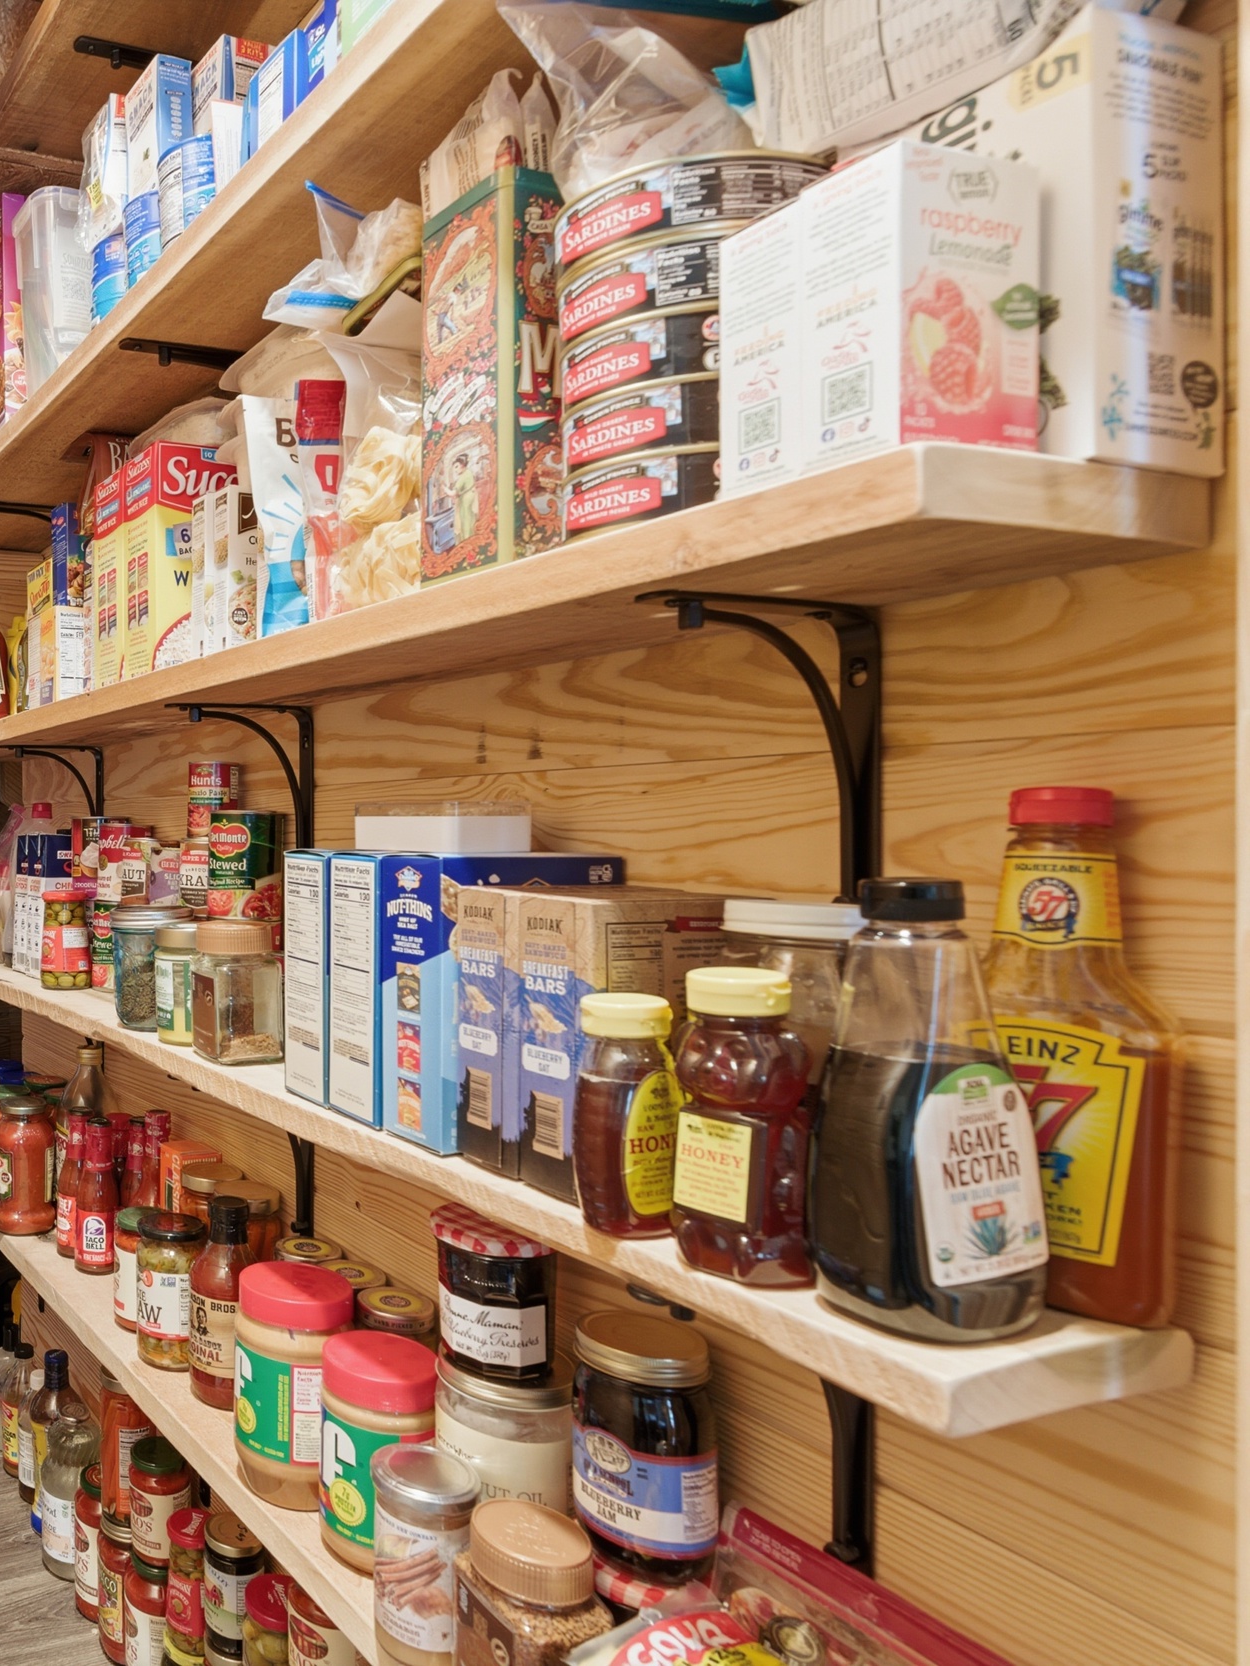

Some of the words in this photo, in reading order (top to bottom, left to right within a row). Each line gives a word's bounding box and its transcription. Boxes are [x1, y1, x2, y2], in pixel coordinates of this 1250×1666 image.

[1035, 53, 1079, 90] 5
[954, 170, 990, 190] TRUE
[531, 222, 550, 231] CASA
[565, 201, 652, 252] SARDINES
[919, 206, 1023, 247] raspberry
[928, 233, 1014, 267] Lemonade
[562, 283, 636, 331] SARDINES
[815, 299, 878, 330] AMERICA
[733, 341, 786, 367] AMERICA
[566, 353, 640, 394] SARDINES
[571, 417, 656, 455] SARDINES
[570, 487, 651, 521] SARDINES
[180, 528, 191, 544] 6
[174, 570, 191, 587] W
[219, 832, 248, 844] Monte
[209, 858, 247, 871] Stewed
[356, 868, 371, 876] Facts
[1013, 862, 1093, 875] SQUEEZABLE
[386, 899, 433, 922] NUT-THINS
[463, 905, 494, 921] KODIAK
[1027, 890, 1065, 921] 57
[526, 916, 564, 933] KODIAK
[459, 945, 499, 964] BREAKFAST
[460, 961, 496, 978] BARS
[522, 960, 569, 980] BREAKFAST
[524, 975, 567, 996] BARS
[462, 1026, 492, 1042] BLUEBERRY
[526, 1047, 563, 1065] BLUEBERRY
[1006, 1036, 1082, 1065] EINZ
[957, 1110, 997, 1126] ORGANIC
[948, 1121, 1011, 1158] AGAVE
[680, 1143, 744, 1169] HONEY
[941, 1150, 1021, 1190] NECTAR
[85, 1235, 105, 1244] TACO
[489, 1331, 540, 1349] Preserves
[334, 1493, 357, 1515] PROTEIN
[581, 1479, 641, 1522] BLUEBERRY
[596, 1505, 617, 1524] JAM
[624, 1617, 737, 1666] GOYA
